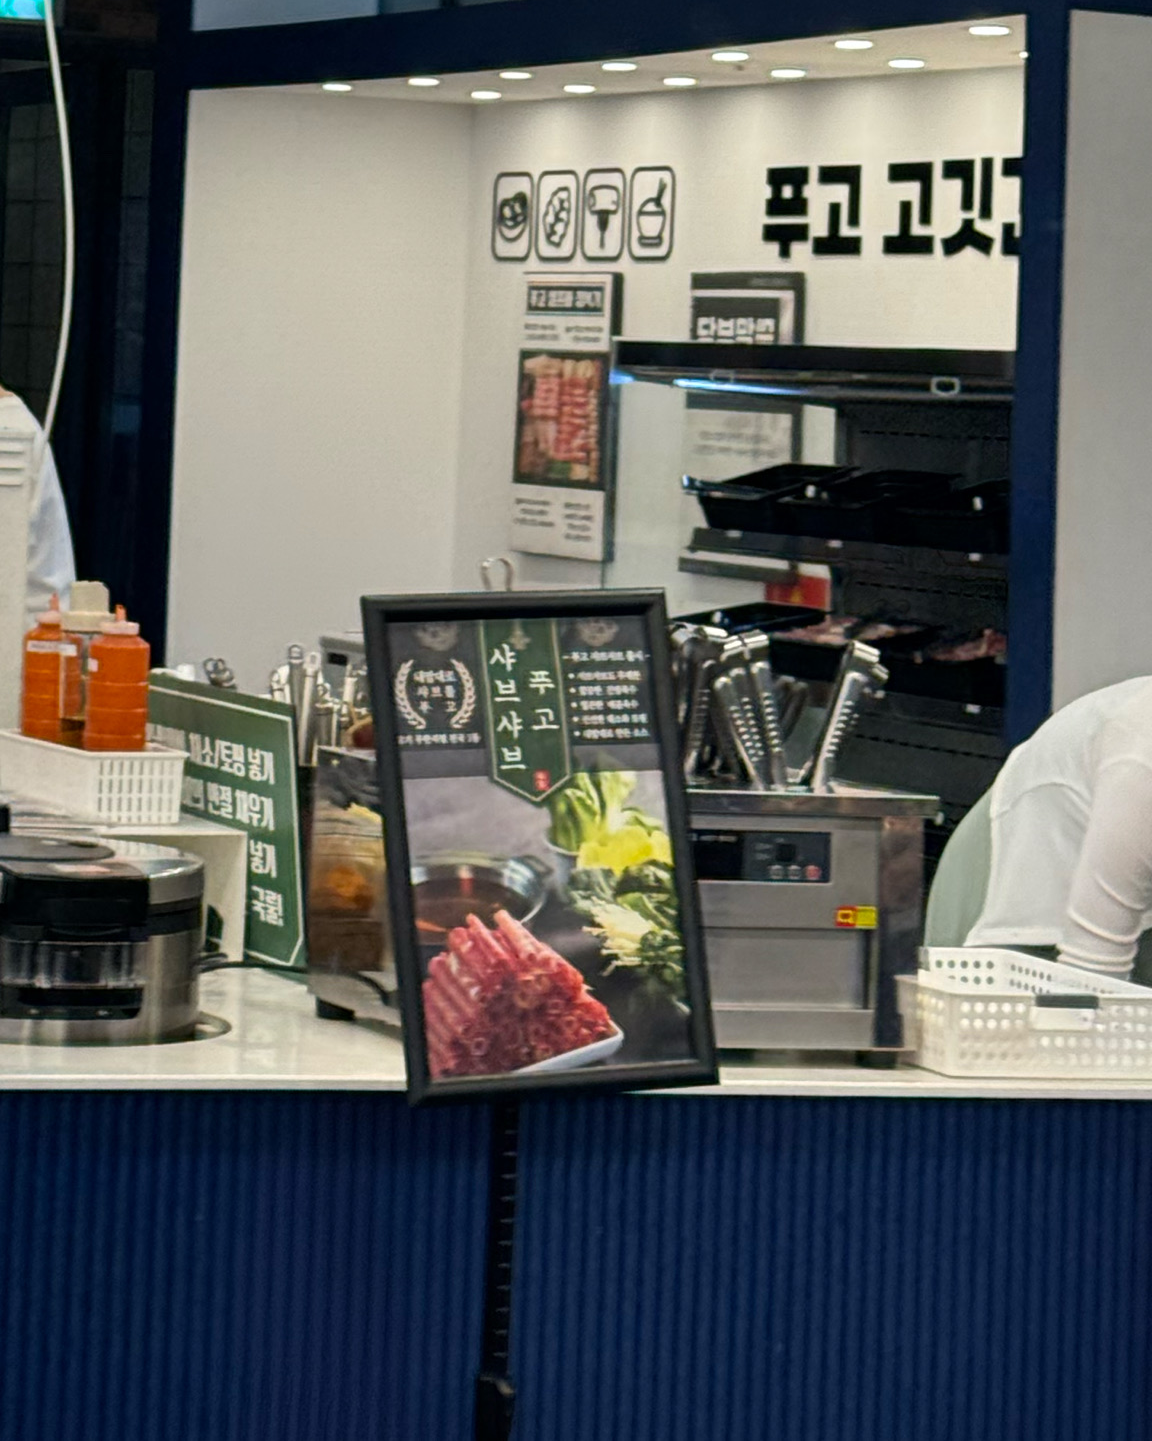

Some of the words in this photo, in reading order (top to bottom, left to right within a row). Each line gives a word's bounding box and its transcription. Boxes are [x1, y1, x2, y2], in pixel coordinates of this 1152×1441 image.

[762, 164, 862, 258] 푸고
[489, 643, 528, 770] 샤브샤브
[529, 670, 560, 732] 푸고
[247, 747, 275, 785] 넣기
[235, 789, 275, 831] 채우기
[250, 839, 277, 879] 넣기
